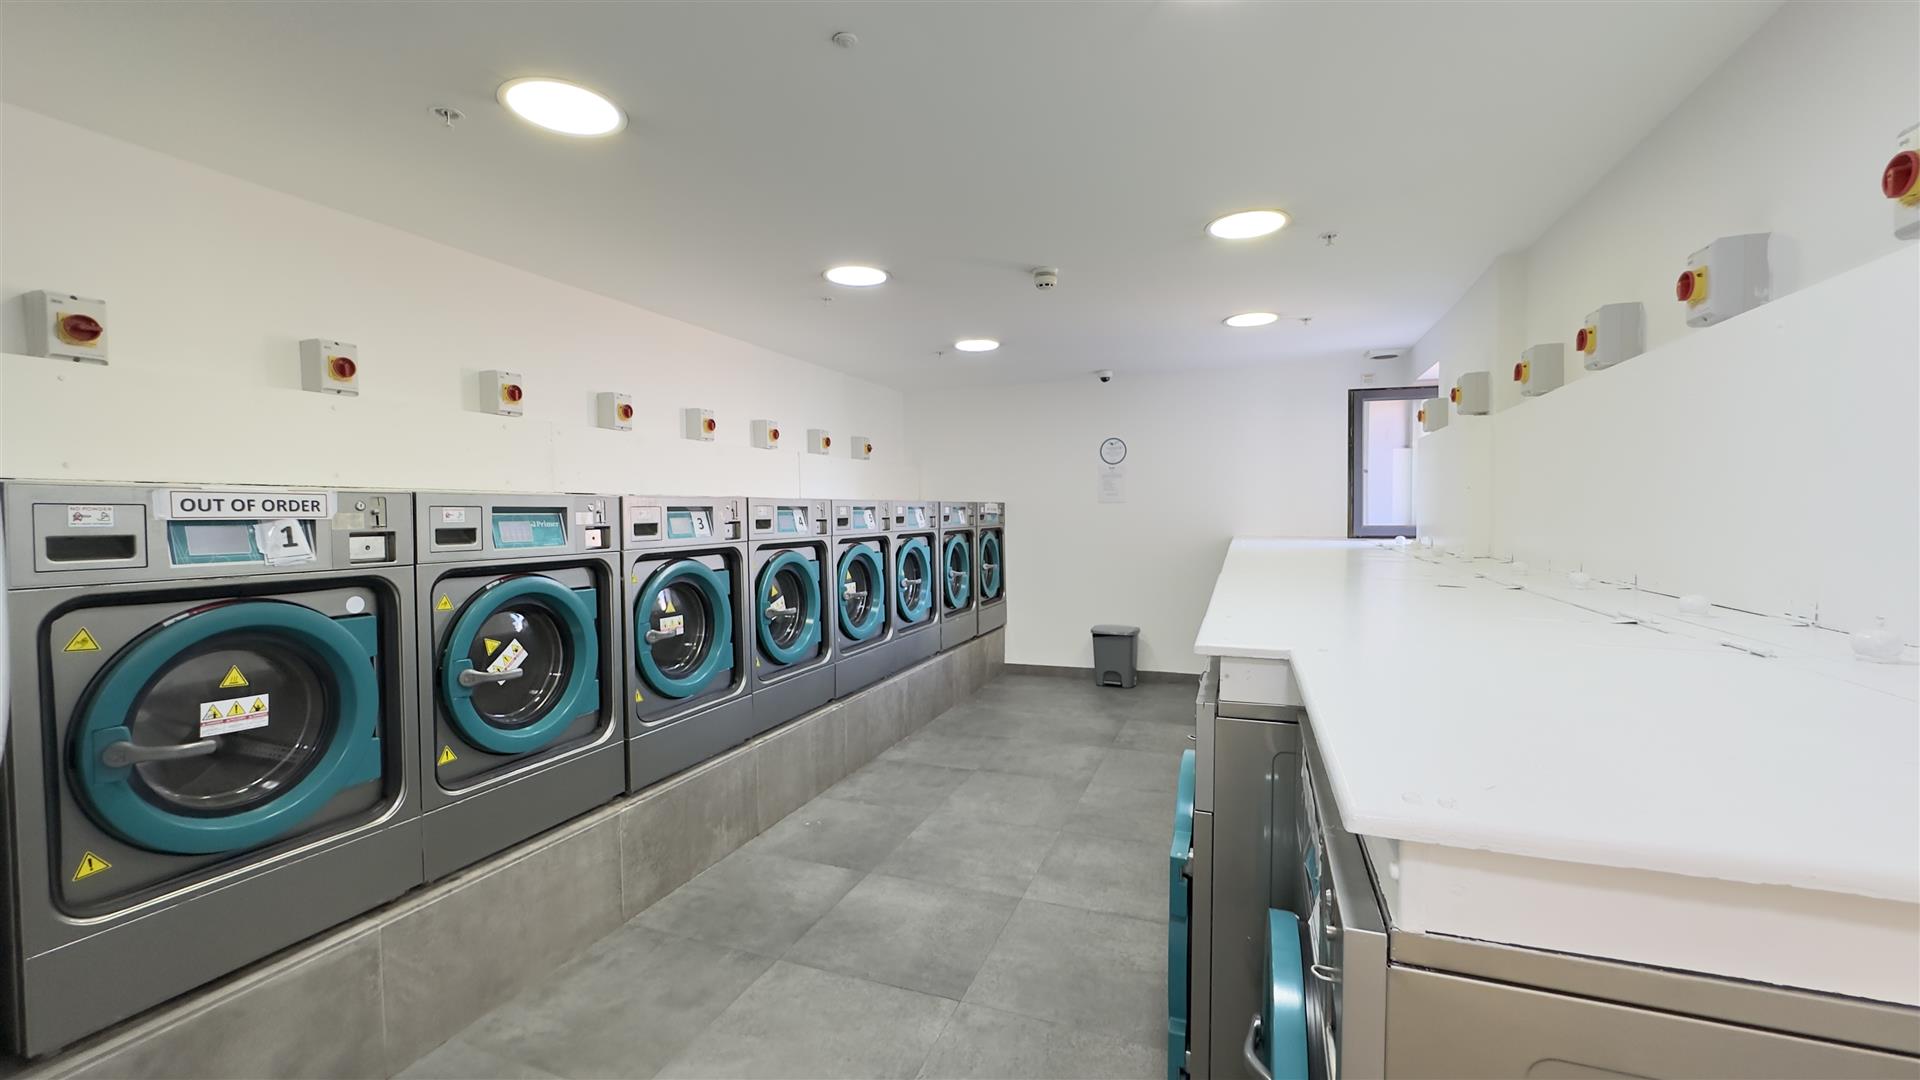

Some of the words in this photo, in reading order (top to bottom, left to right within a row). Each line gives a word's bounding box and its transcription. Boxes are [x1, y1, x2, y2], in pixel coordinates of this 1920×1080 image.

[180, 498, 225, 512] OUT
[231, 499, 256, 512] OF
[261, 499, 321, 512] ORDER
[697, 517, 705, 530] 3
[280, 526, 298, 548] 1
